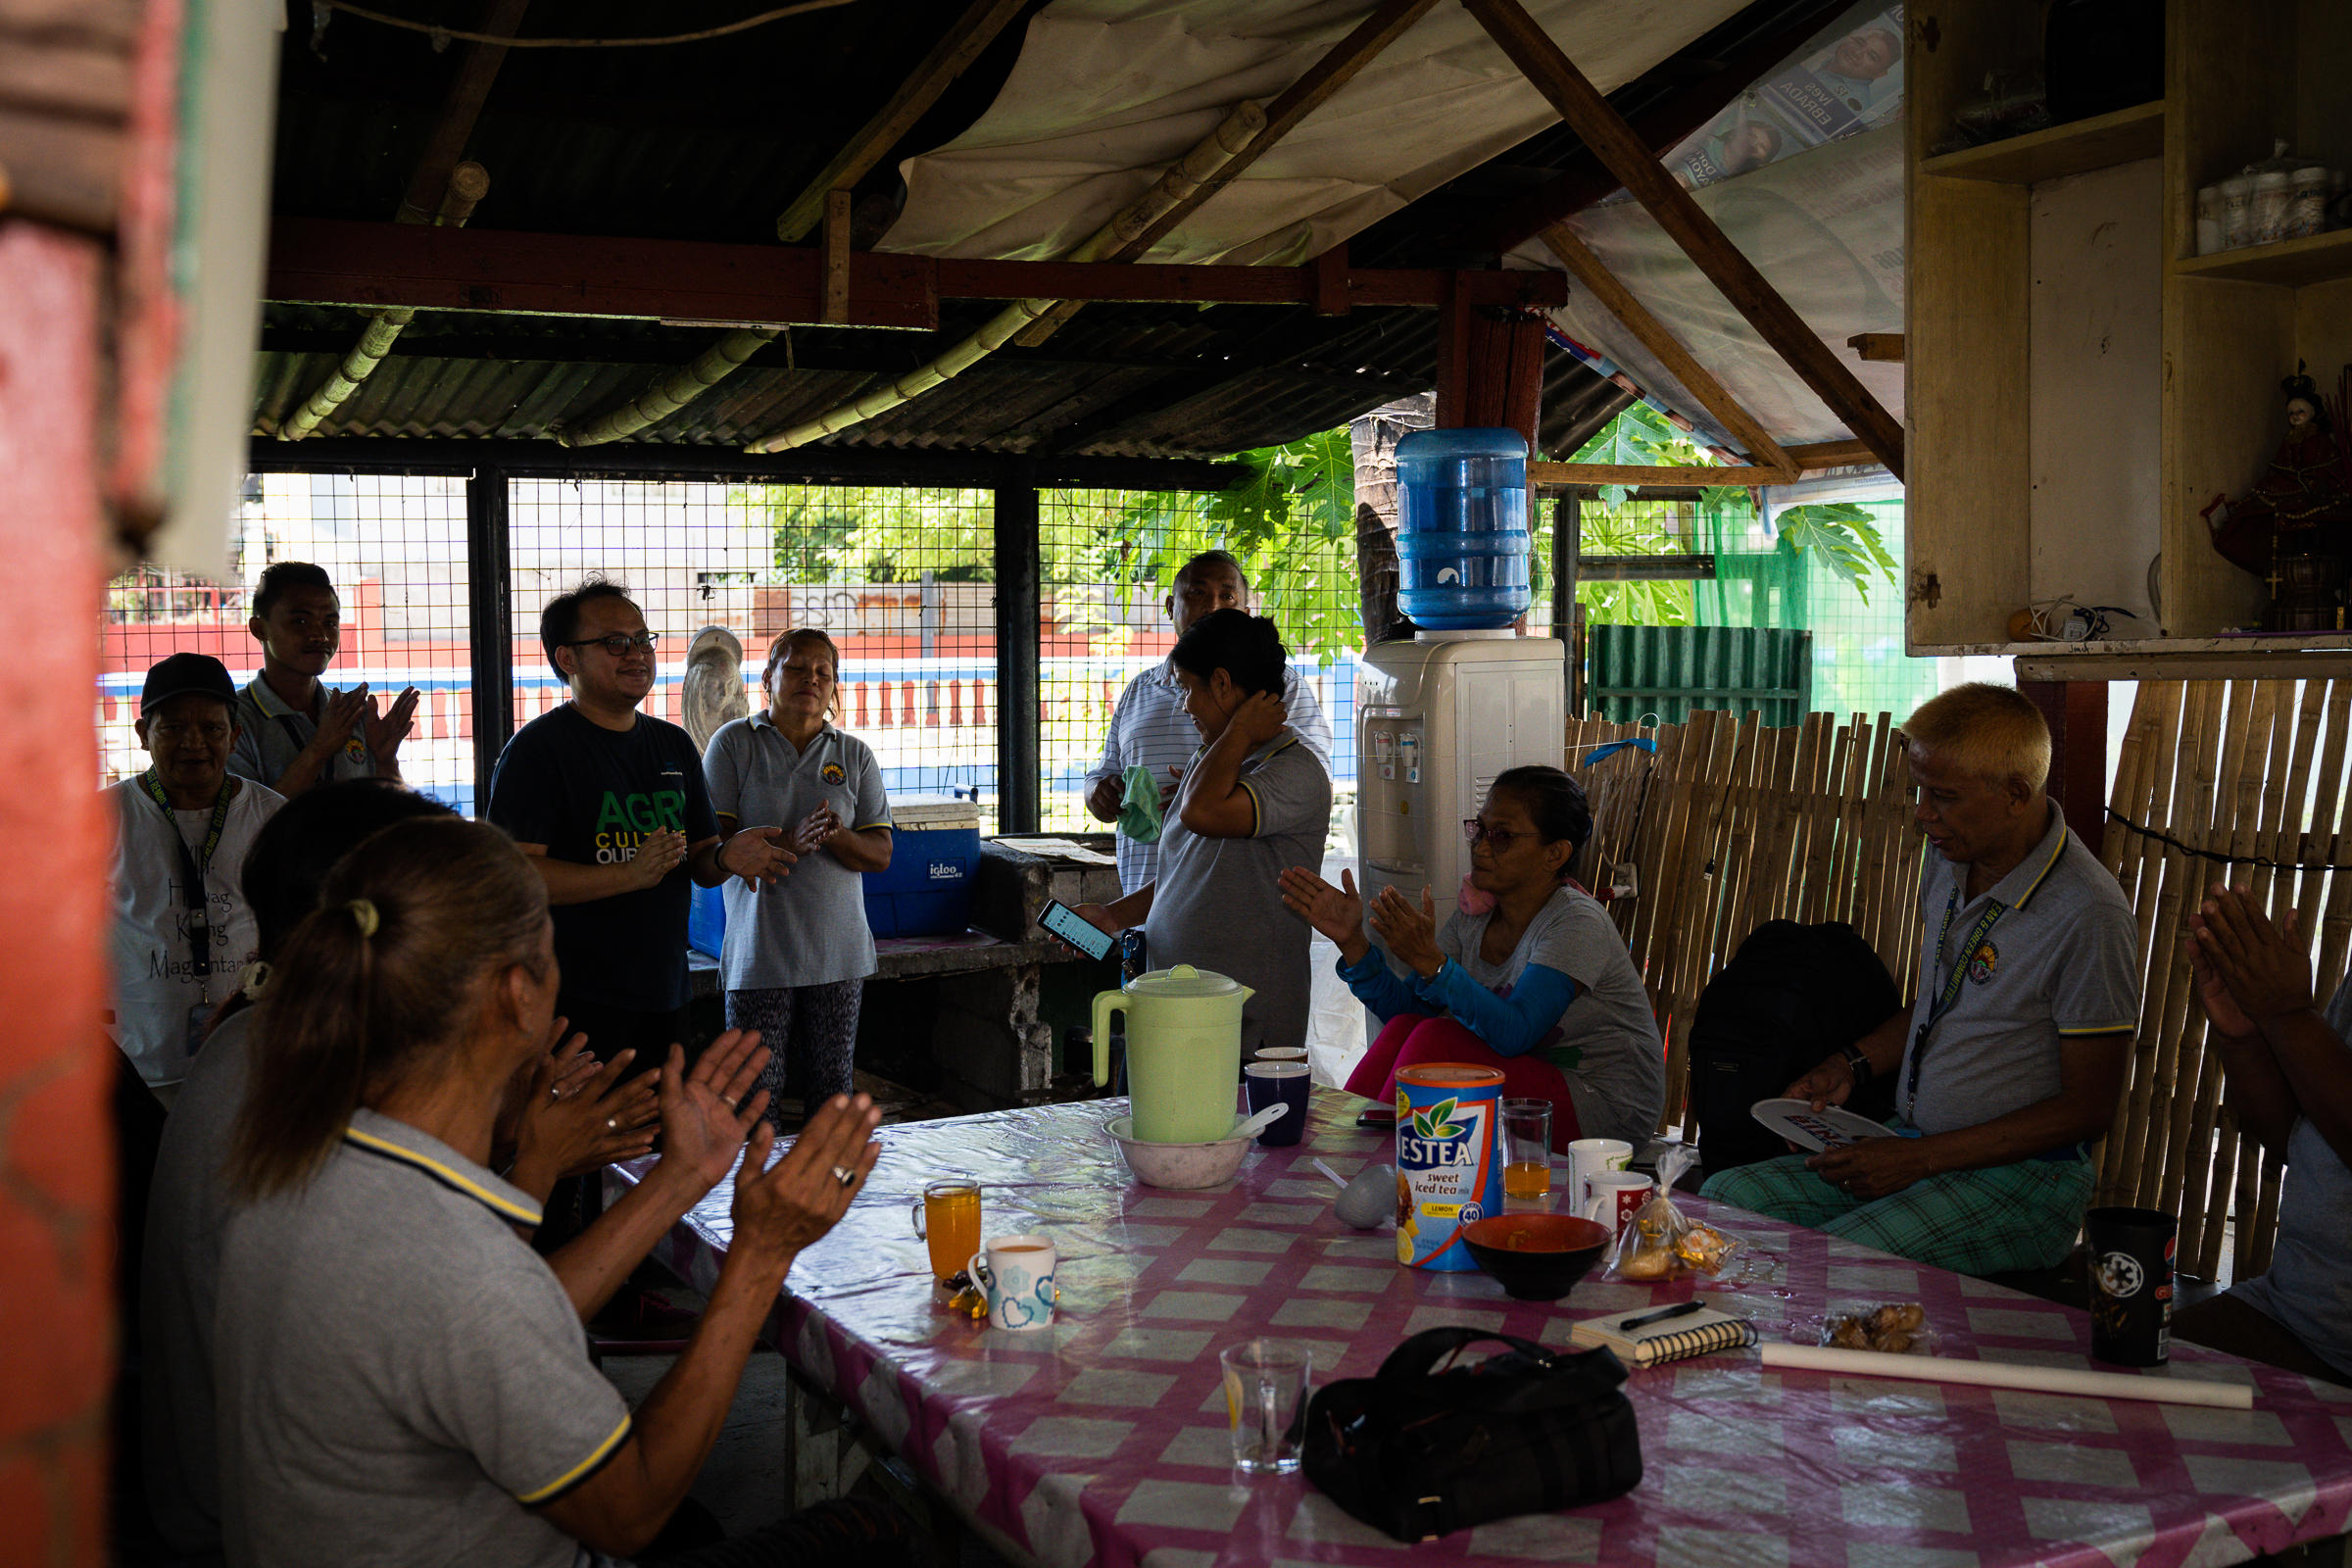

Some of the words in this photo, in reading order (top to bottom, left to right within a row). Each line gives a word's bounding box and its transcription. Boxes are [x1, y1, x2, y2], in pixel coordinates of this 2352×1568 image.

[150, 780, 168, 806] REMBO
[929, 862, 957, 876] igloo
[1965, 927, 1984, 955] GREEN
[1942, 956, 1970, 1004] COMMITTEE
[1427, 1172, 1460, 1184] sweet
[1414, 1181, 1436, 1195] iced
[1439, 1183, 1457, 1195] tea
[1464, 1210, 1478, 1221] 40
